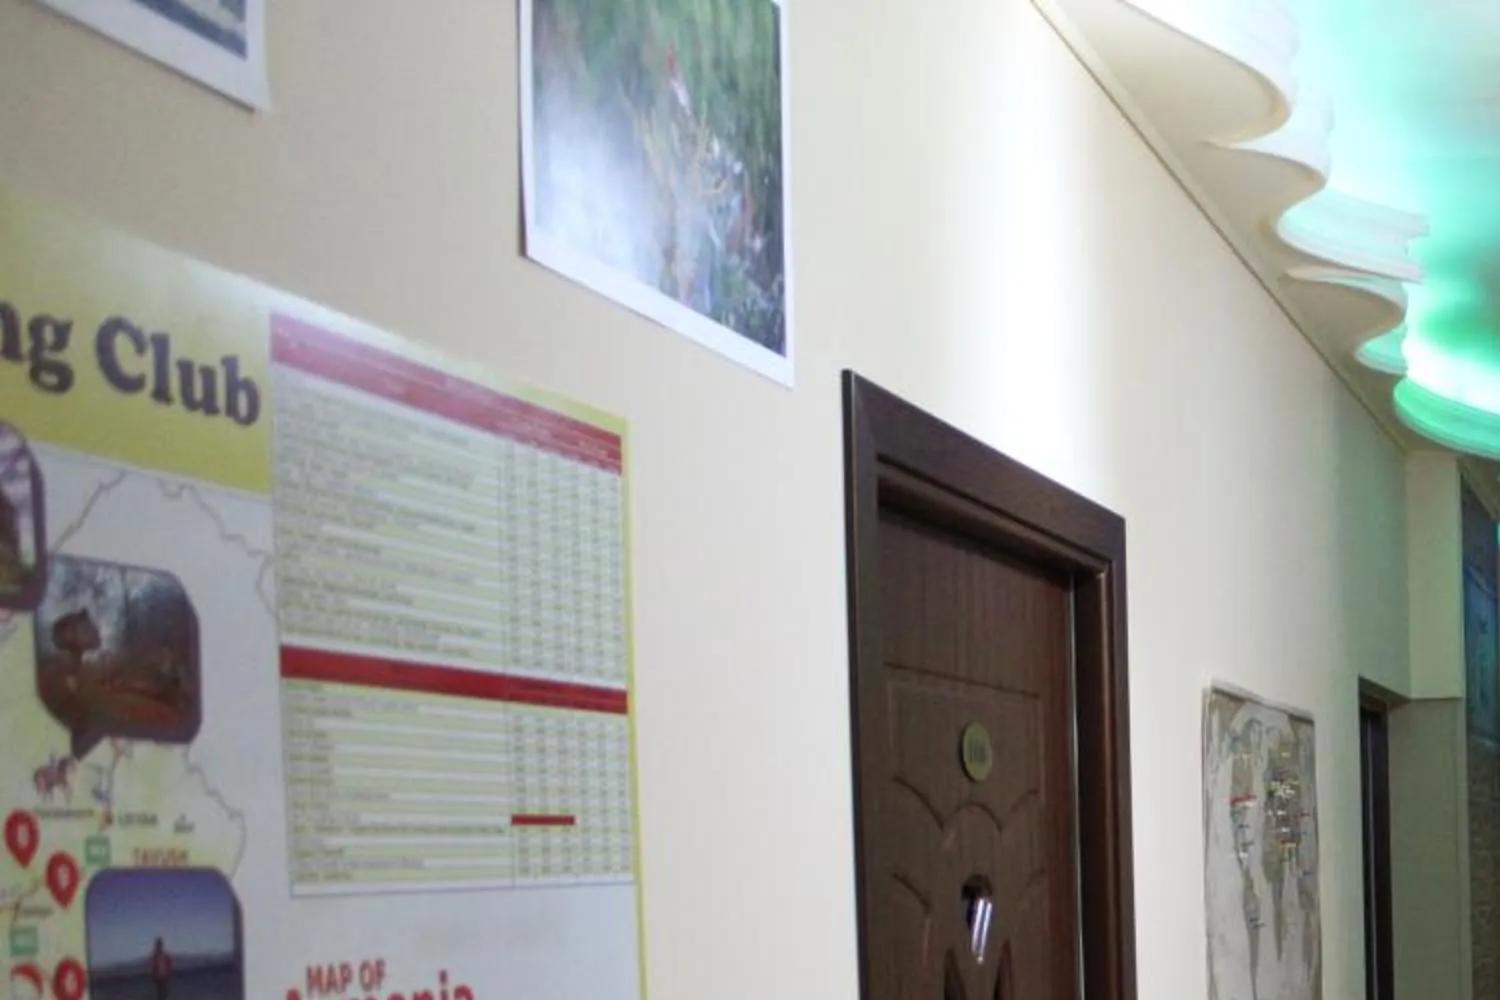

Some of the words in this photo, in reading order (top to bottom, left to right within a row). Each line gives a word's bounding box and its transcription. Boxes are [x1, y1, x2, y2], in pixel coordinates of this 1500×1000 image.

[94, 312, 263, 427] Club
[305, 961, 353, 996] MAP
[358, 956, 387, 993] OF
